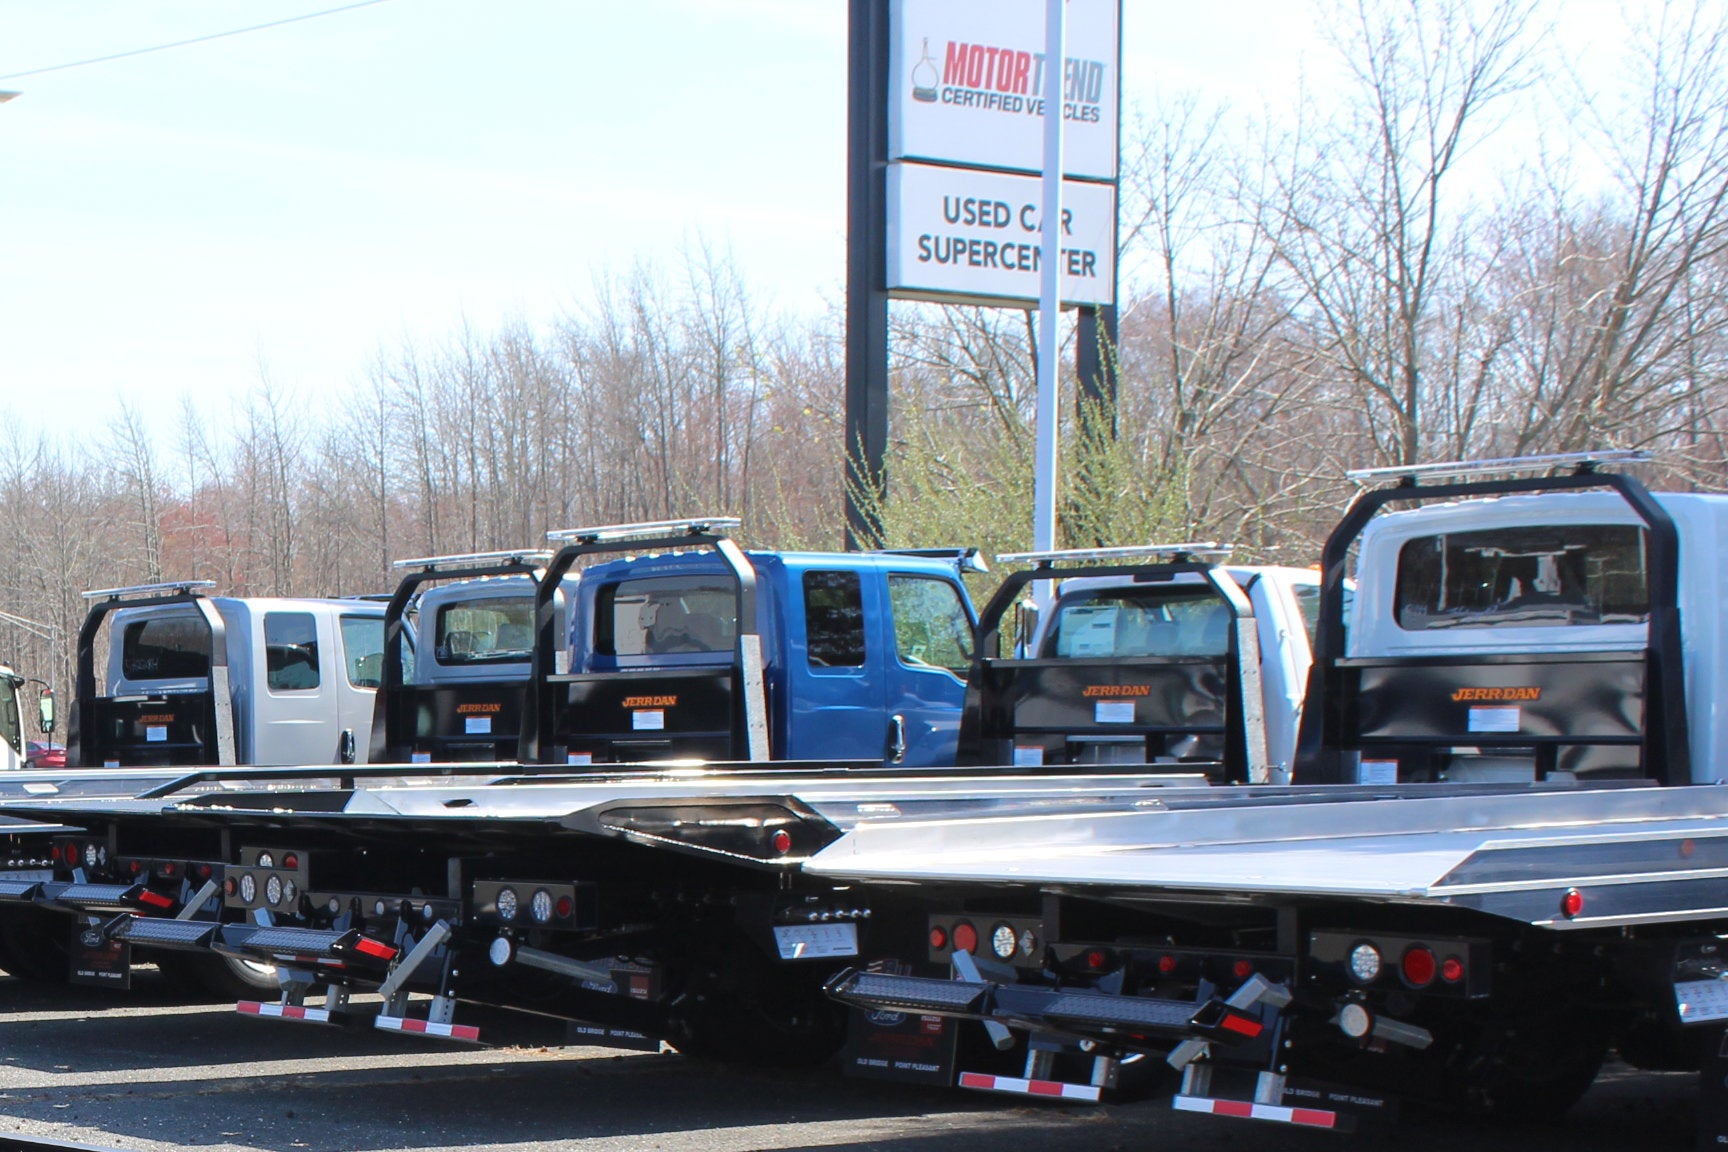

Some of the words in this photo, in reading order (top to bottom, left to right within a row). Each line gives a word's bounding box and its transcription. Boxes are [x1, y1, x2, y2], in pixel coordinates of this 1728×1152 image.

[943, 41, 1104, 104] MOTORTEND
[941, 86, 1023, 113] CERTIFIED
[1025, 97, 1101, 123] VECLES
[943, 195, 1011, 229] USED
[1019, 204, 1073, 236] CR
[917, 233, 1097, 278] SUPERCENER
